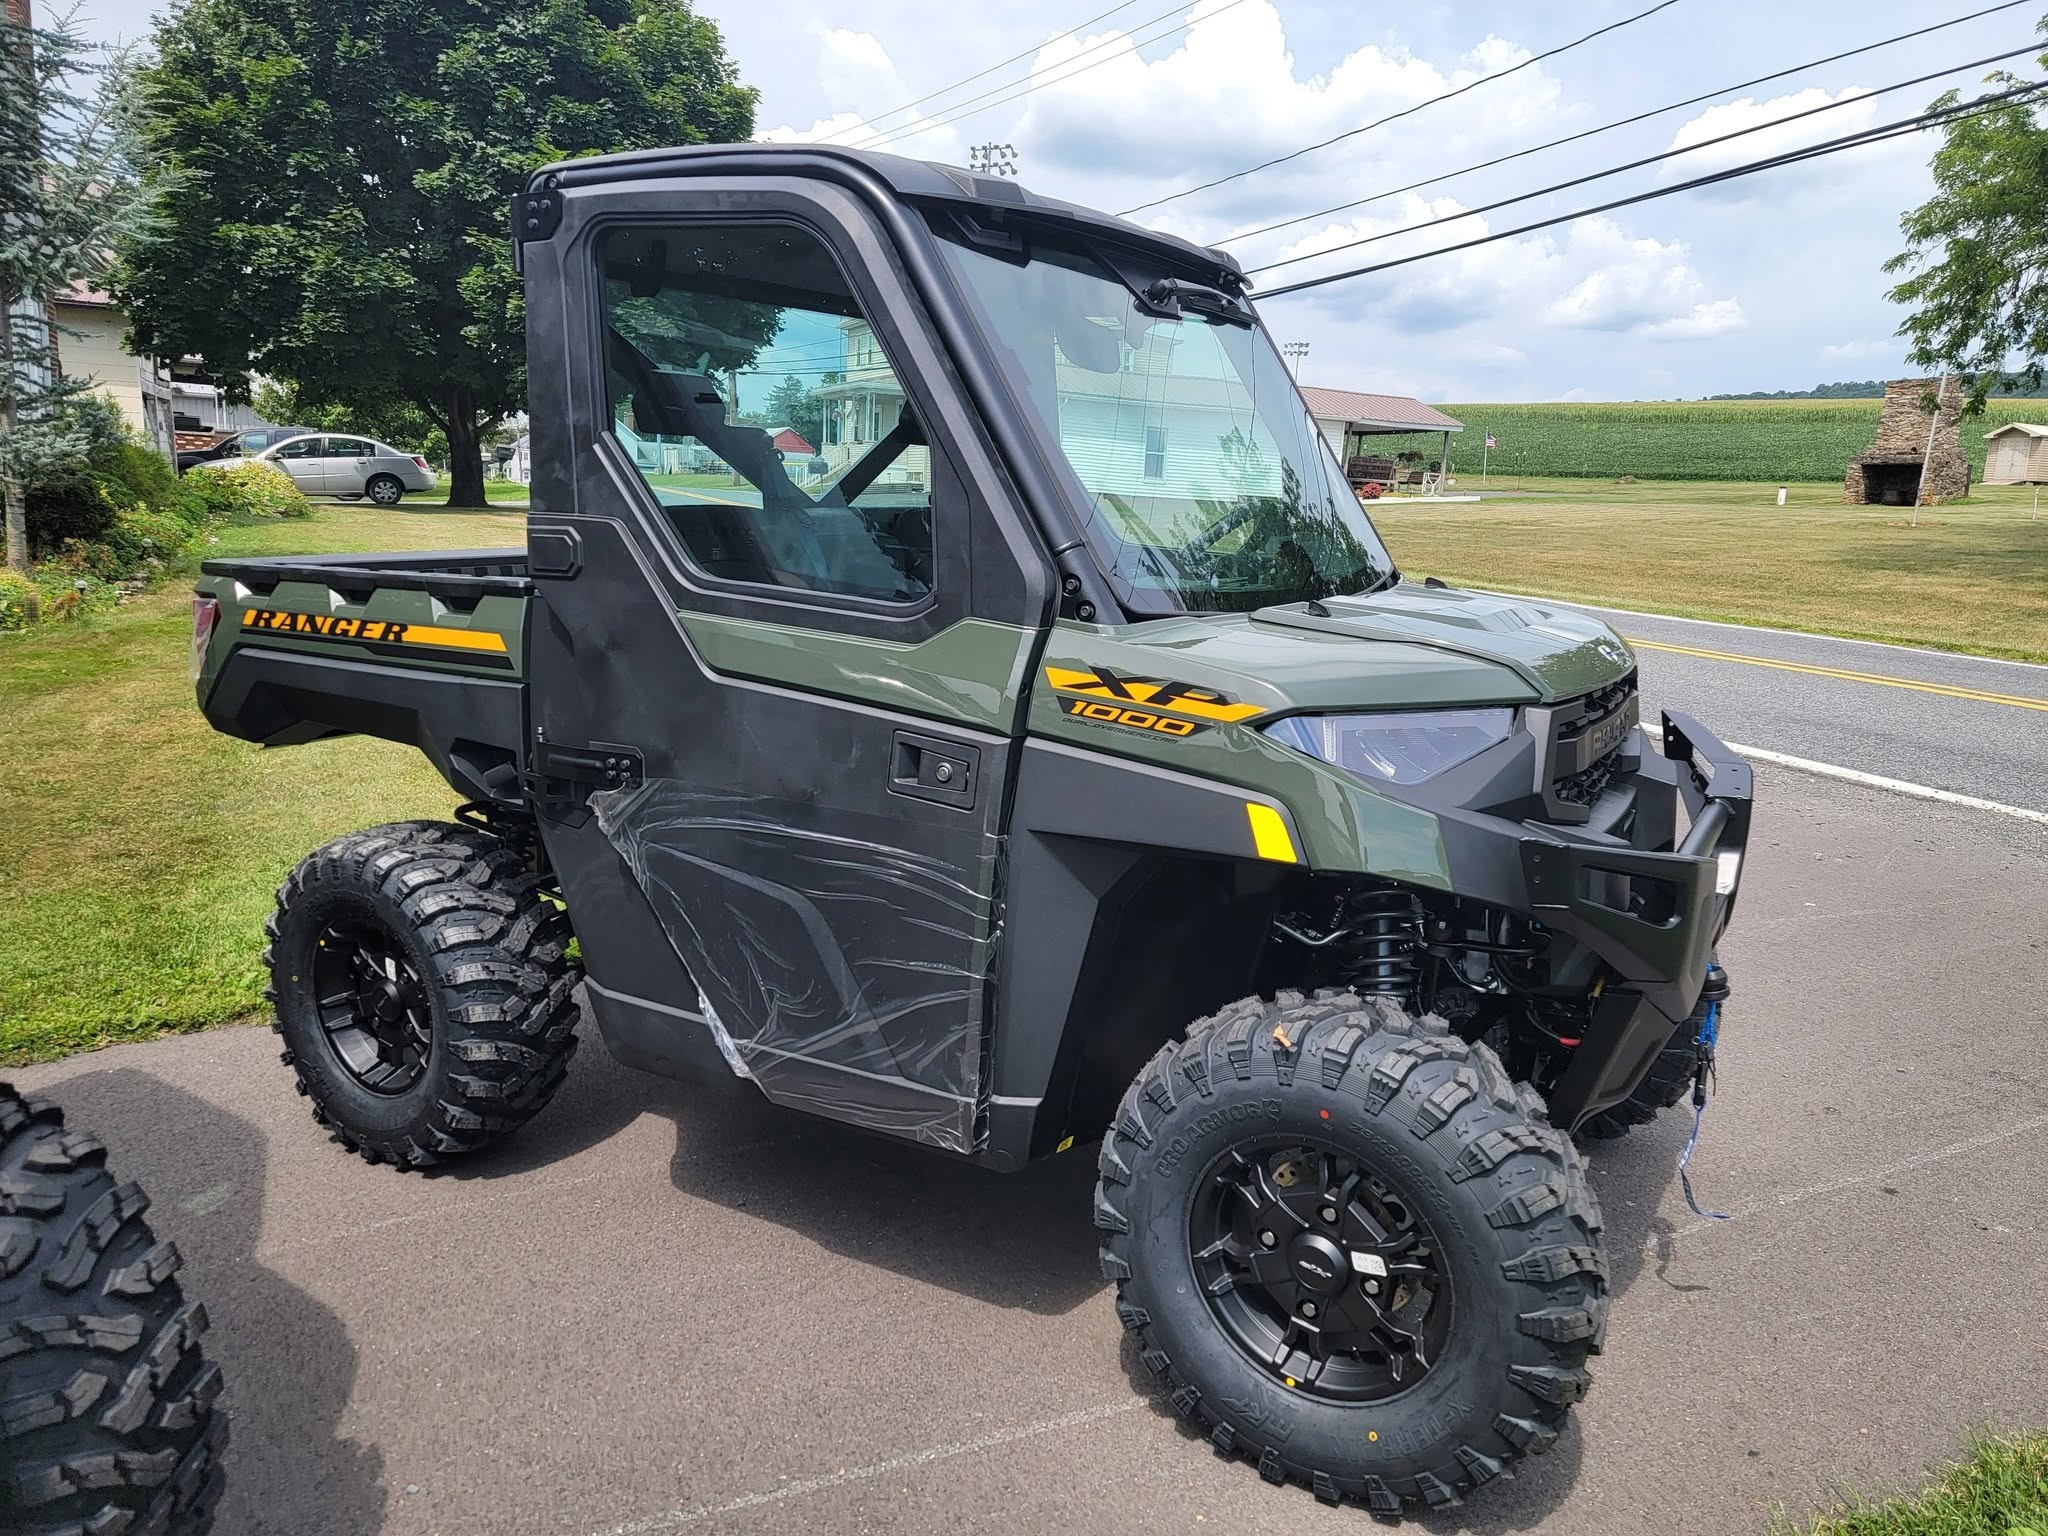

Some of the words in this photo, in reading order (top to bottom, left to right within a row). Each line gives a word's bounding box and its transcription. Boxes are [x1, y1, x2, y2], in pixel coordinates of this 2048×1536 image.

[251, 610, 409, 643] RANGER
[1060, 665, 1241, 706] XP
[1062, 717, 1091, 728] DUAL
[1092, 723, 1151, 739] OVERHEAD
[1153, 735, 1179, 745] CAM
[1070, 701, 1197, 736] 1000
[1155, 1138, 1190, 1178] PRO
[1186, 1101, 1262, 1144] ARMOR
